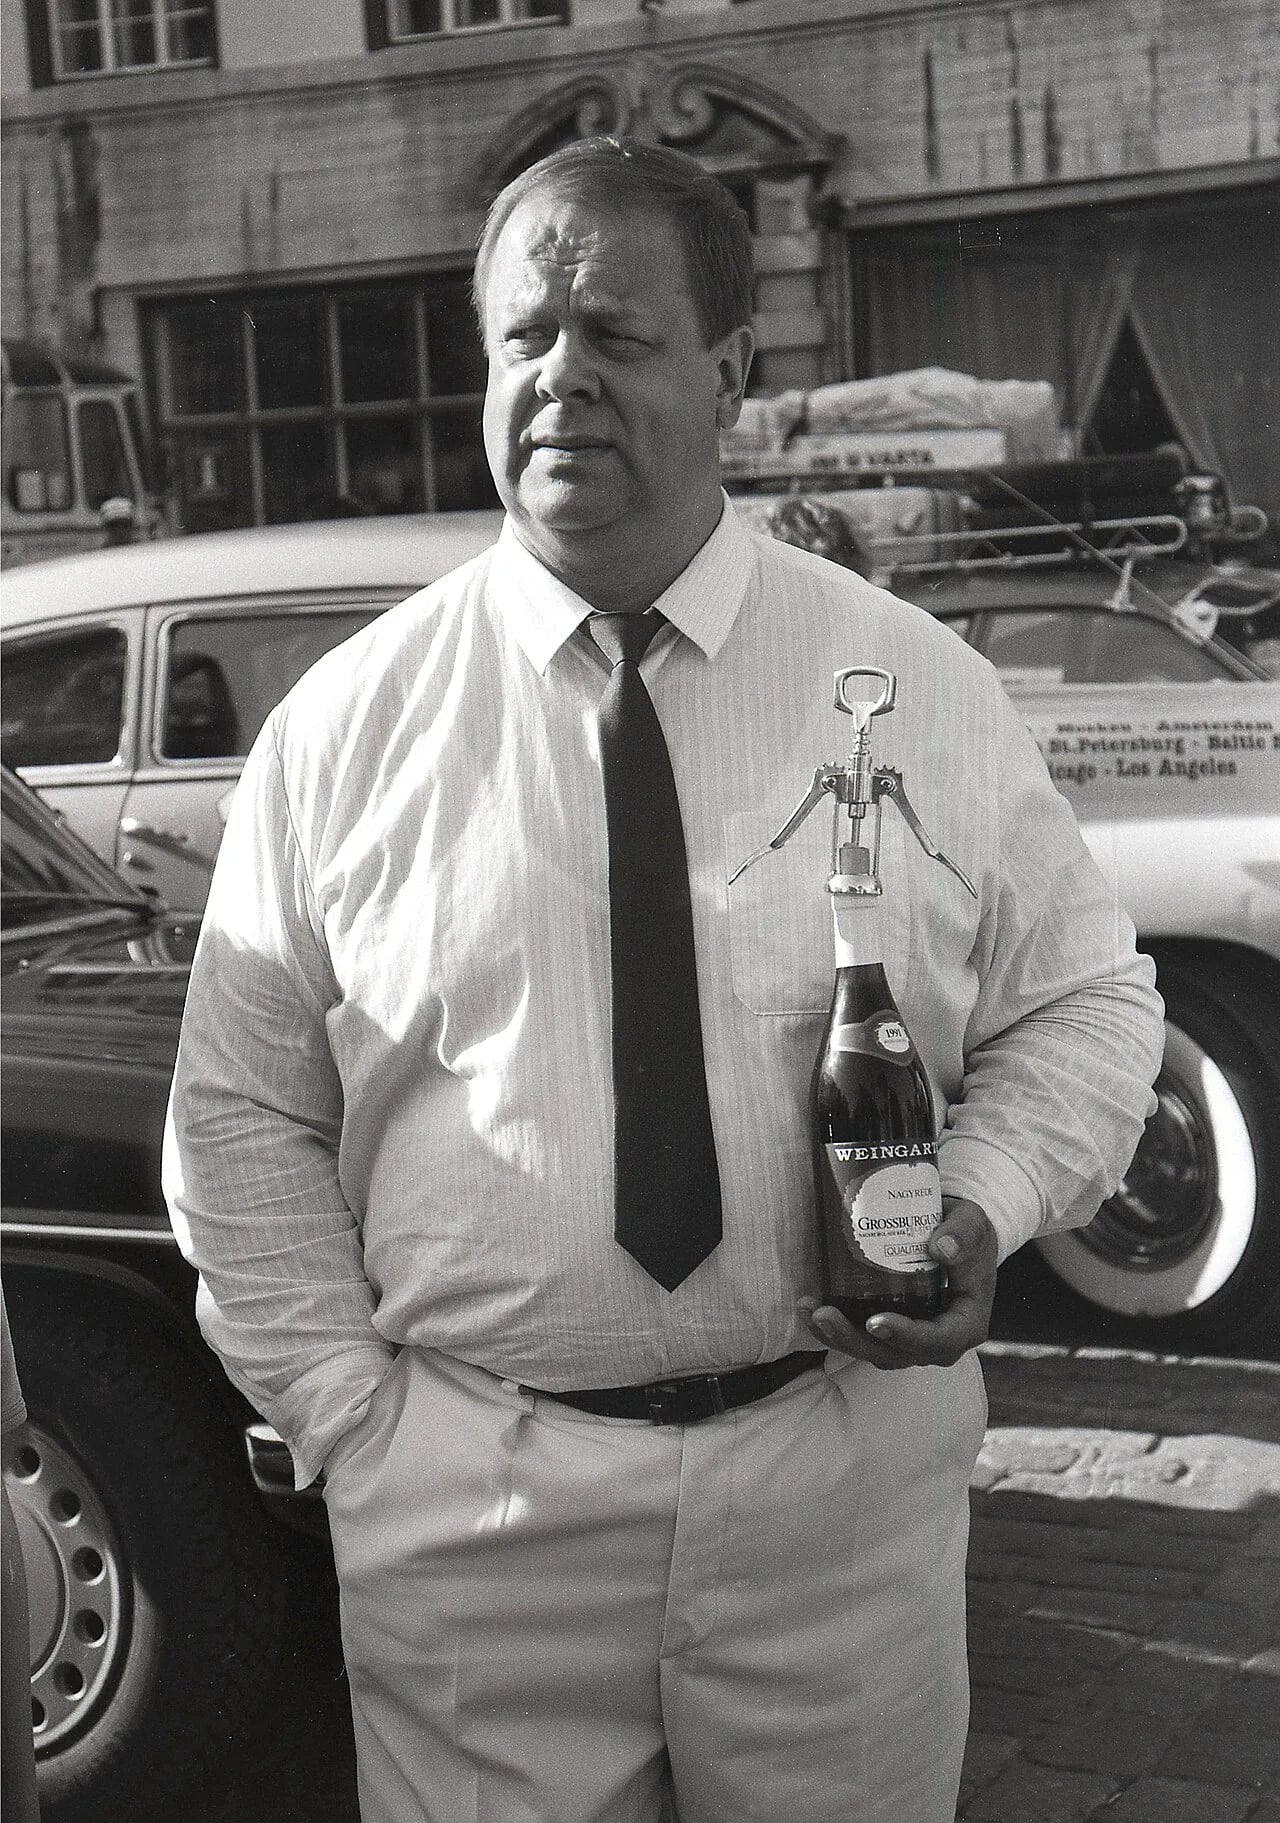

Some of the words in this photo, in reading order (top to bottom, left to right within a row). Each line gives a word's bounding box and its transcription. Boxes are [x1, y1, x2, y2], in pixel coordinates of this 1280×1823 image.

[1157, 721, 1273, 732] Amsterdam
[1208, 734, 1265, 751] Baltic
[1117, 757, 1150, 777] Los
[1158, 756, 1237, 780] Angeles
[886, 1028, 902, 1038] 1991
